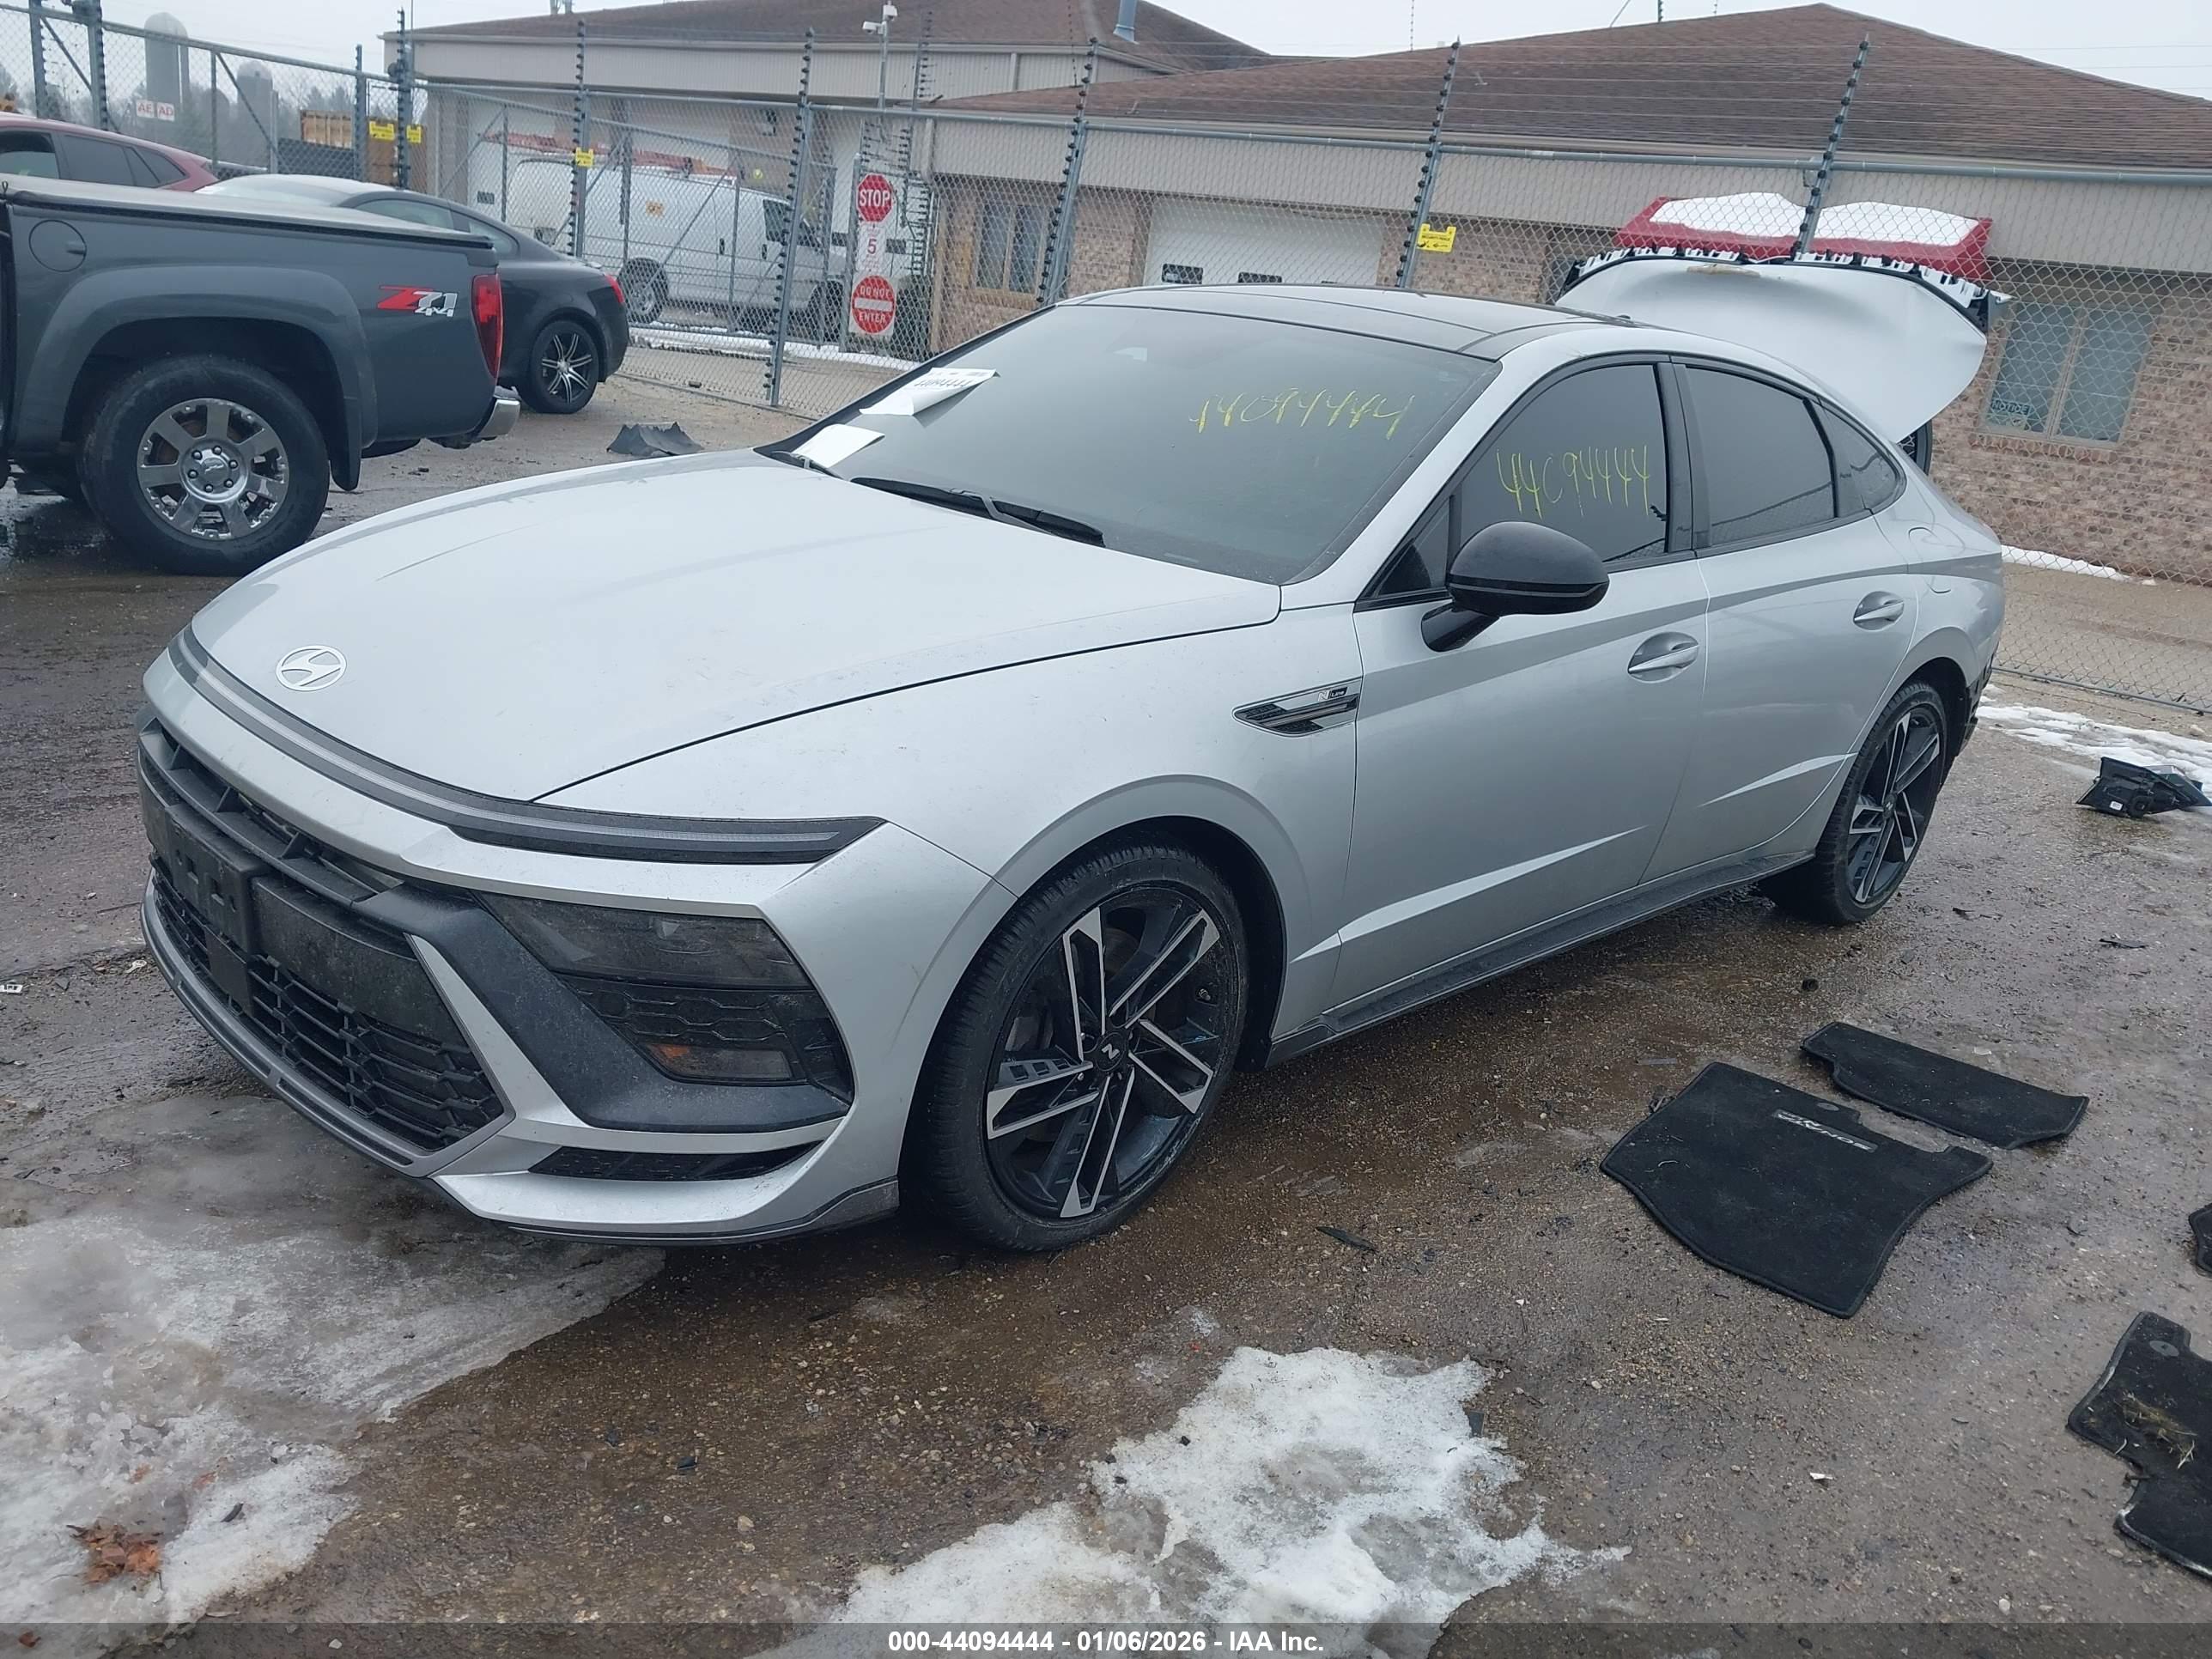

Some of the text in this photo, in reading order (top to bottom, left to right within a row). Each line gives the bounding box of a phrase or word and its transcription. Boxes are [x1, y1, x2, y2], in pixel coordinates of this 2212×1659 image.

[860, 189, 890, 207] STOP
[867, 238, 877, 255] 5
[378, 285, 458, 310] Z71
[860, 284, 890, 298] DO NOT
[859, 310, 886, 325] ENTER
[1991, 399, 2030, 414] NOTICE
